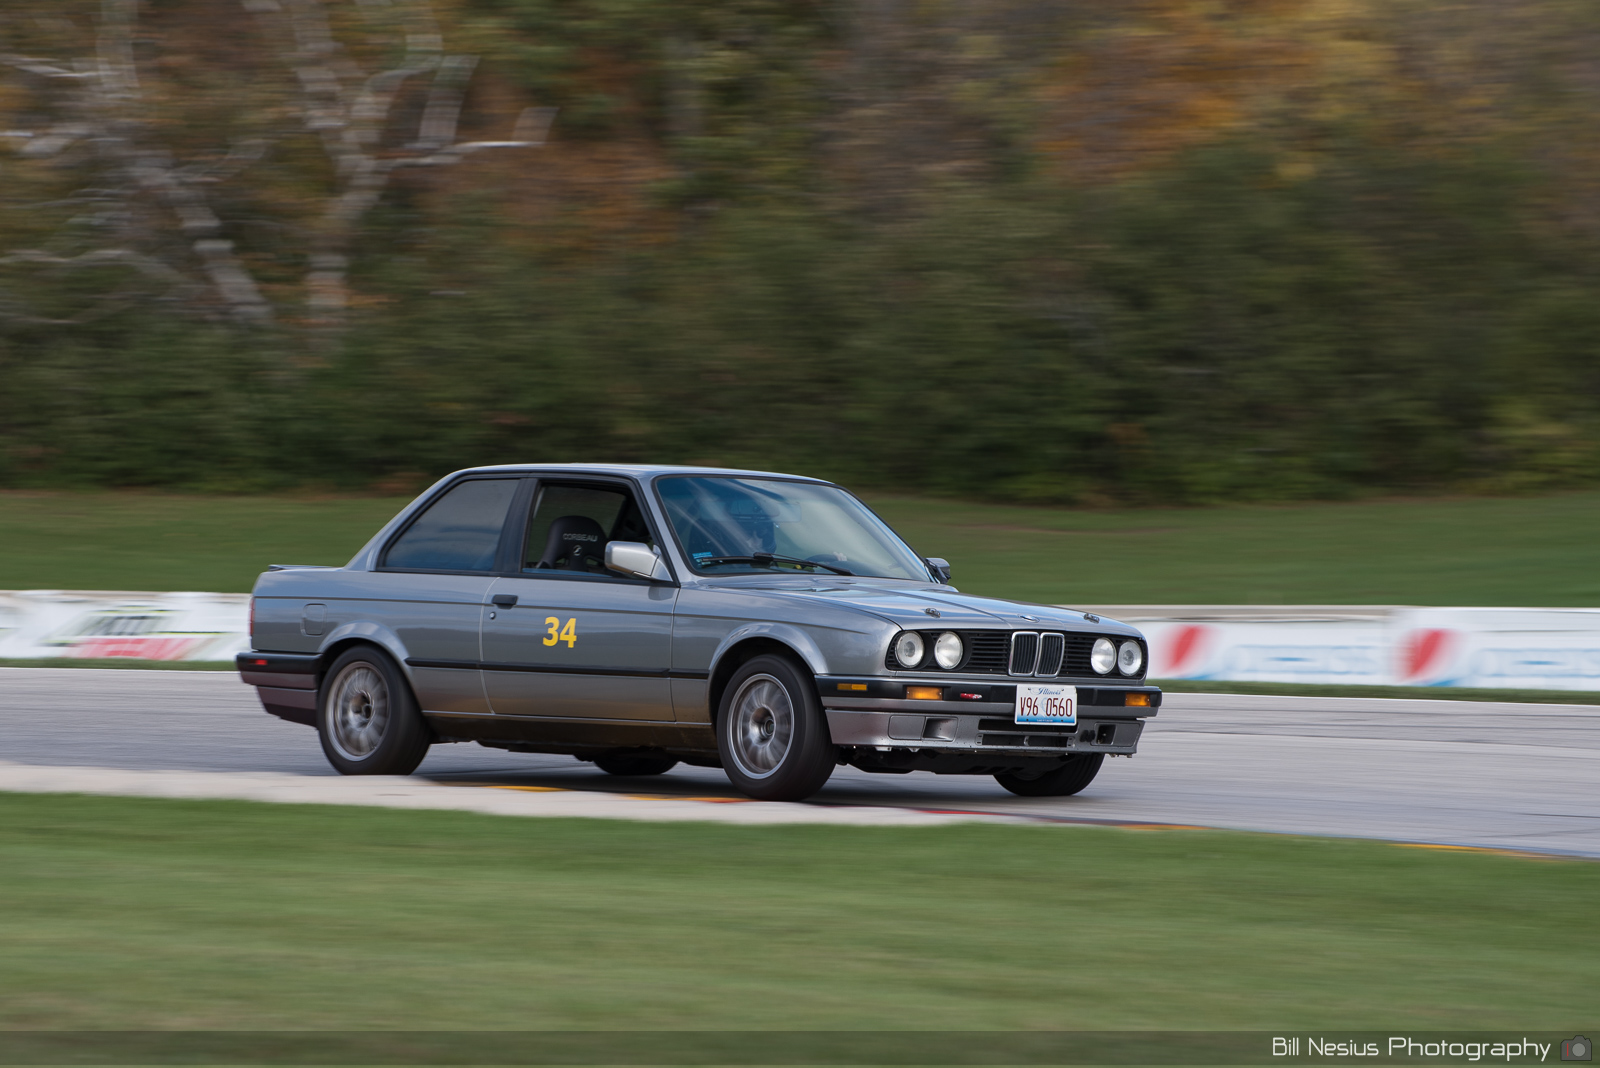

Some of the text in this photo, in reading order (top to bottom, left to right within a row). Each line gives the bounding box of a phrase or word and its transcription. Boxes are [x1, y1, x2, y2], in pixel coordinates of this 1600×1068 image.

[562, 533, 598, 542] CORBEAU
[542, 616, 577, 648] 34
[1037, 687, 1061, 695] Illinois
[1020, 697, 1073, 717] V96 0560
